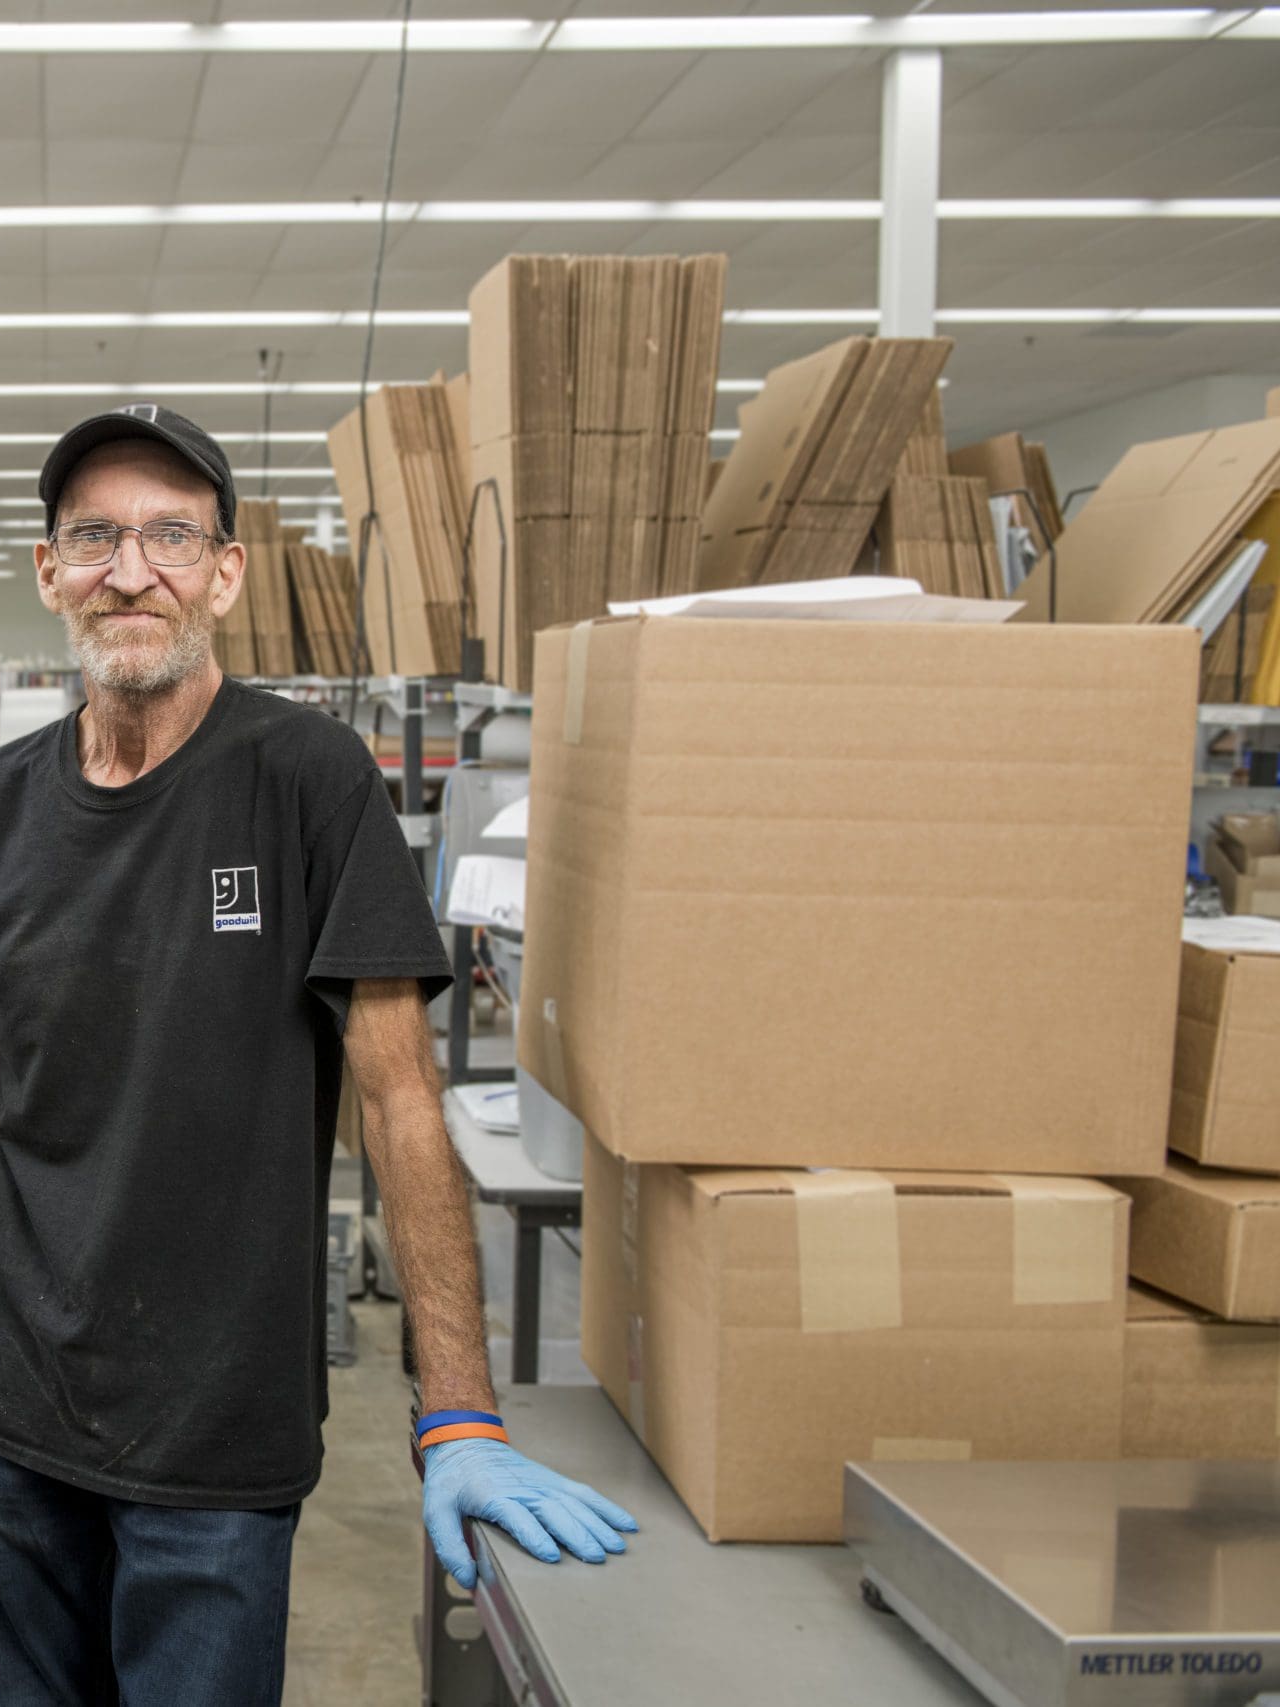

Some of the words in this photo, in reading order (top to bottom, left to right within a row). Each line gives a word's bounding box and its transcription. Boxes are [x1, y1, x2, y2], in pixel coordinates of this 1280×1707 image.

[215, 915, 258, 929] goodwill
[1080, 1653, 1175, 1676] METTLER
[1180, 1652, 1263, 1675] TOLEDO
